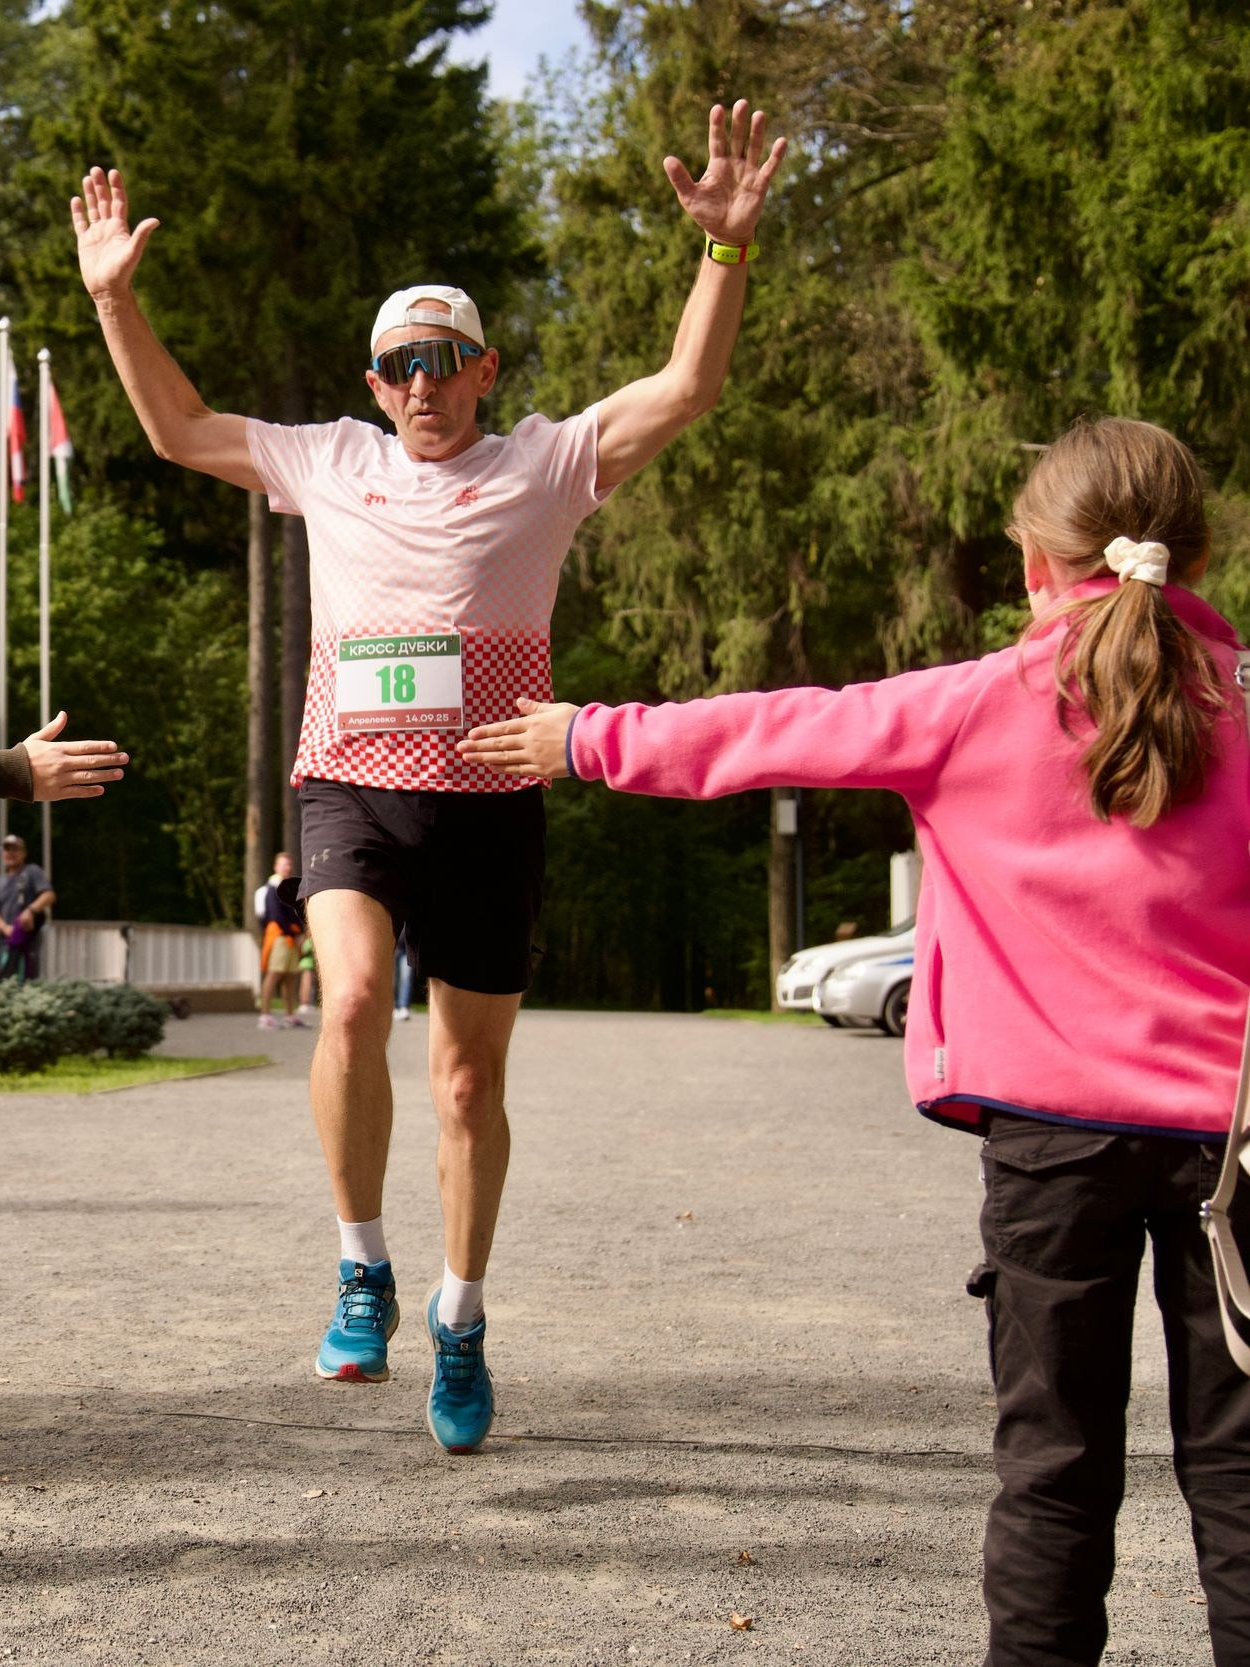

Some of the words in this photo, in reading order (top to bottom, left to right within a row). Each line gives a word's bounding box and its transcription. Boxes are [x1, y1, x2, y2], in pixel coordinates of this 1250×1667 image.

[349, 642, 395, 657] КРОСС
[398, 640, 448, 655] ДУБКИ
[375, 664, 416, 704] 18
[348, 716, 397, 726] Апрелевка
[405, 713, 449, 723] 14.09.25
